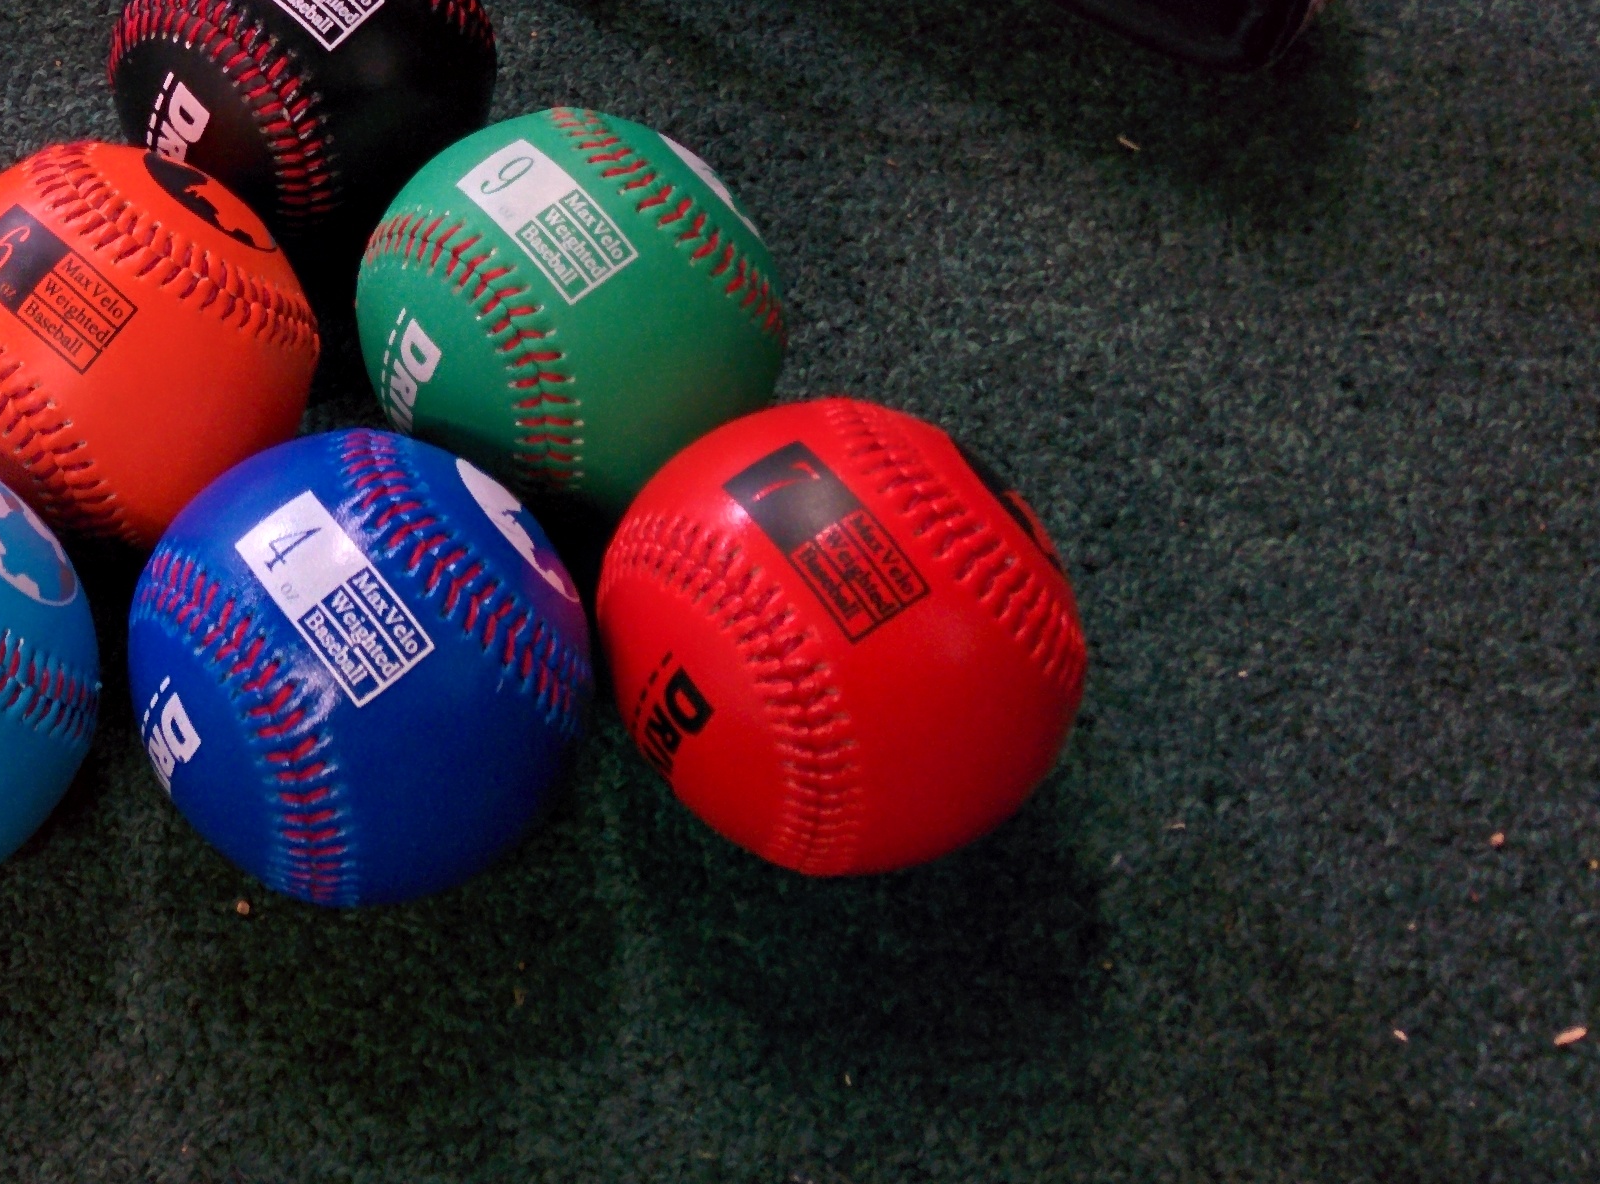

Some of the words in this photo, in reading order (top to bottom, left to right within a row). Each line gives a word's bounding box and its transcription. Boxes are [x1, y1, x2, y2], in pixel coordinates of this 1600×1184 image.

[521, 224, 578, 286] Baseball
[544, 207, 609, 281] Weighted
[24, 301, 84, 357] Baseball
[44, 277, 111, 344] Weighted
[264, 526, 323, 573] 4
[304, 608, 368, 687] Baseball
[331, 589, 401, 679] Weighted
